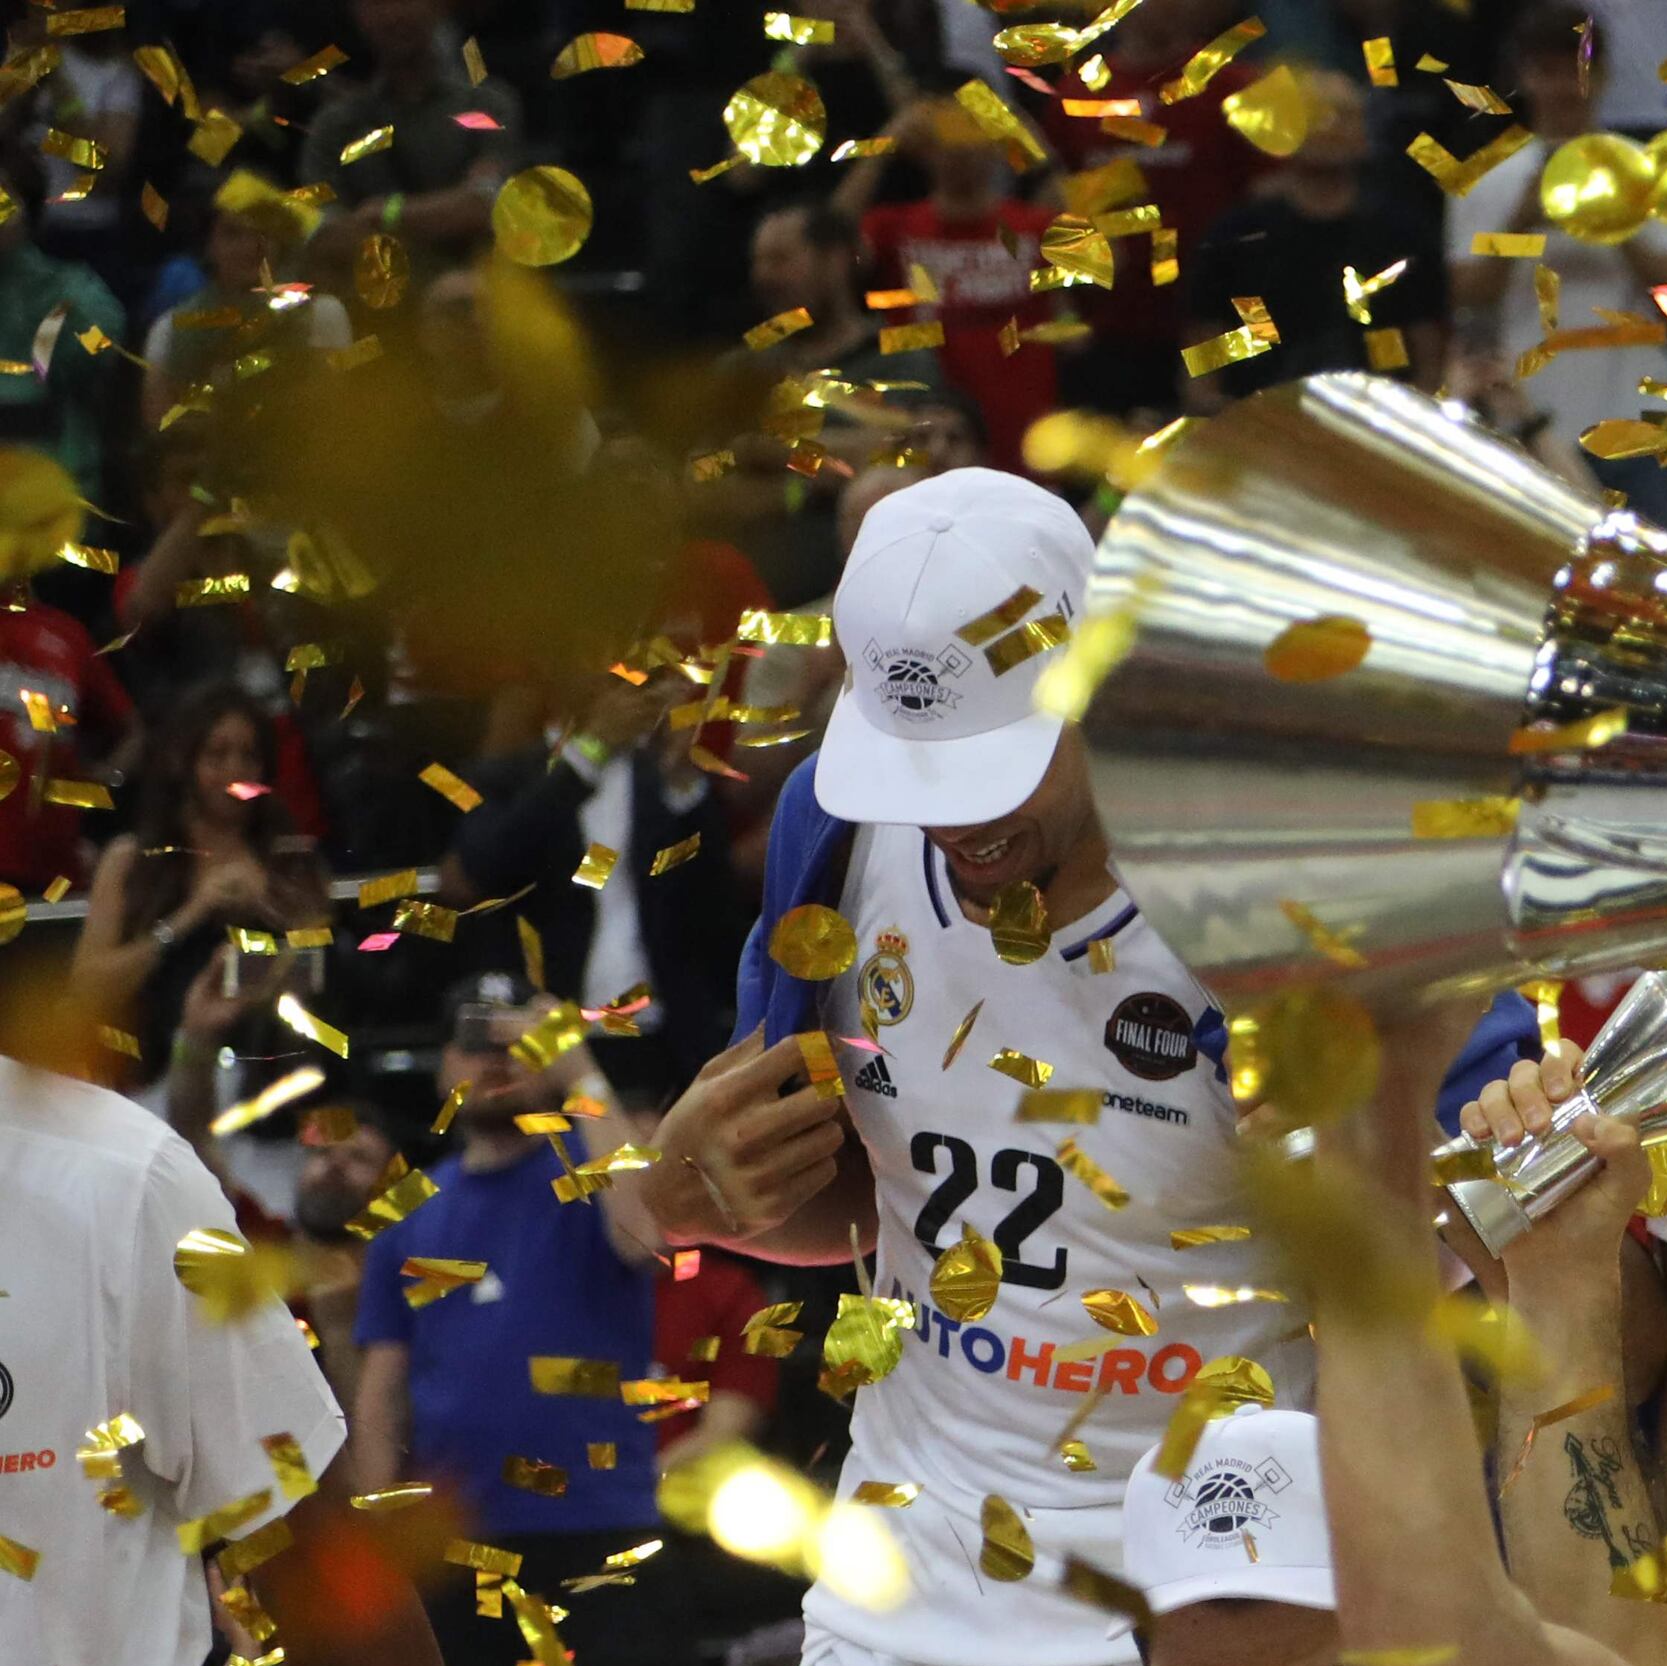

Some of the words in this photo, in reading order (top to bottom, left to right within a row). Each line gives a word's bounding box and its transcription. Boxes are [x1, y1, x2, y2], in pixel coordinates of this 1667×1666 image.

[880, 682, 945, 700] CAMPEONES
[1115, 1020, 1151, 1051] FINAL
[1153, 1028, 1189, 1059] FOUR
[855, 1074, 898, 1099] adidas
[1101, 1090, 1188, 1125] oneteam
[910, 1131, 1068, 1291] 22
[1193, 1462, 1214, 1480] REAL
[1215, 1457, 1253, 1473] MADRID
[1190, 1500, 1260, 1525] CAMPEONES
